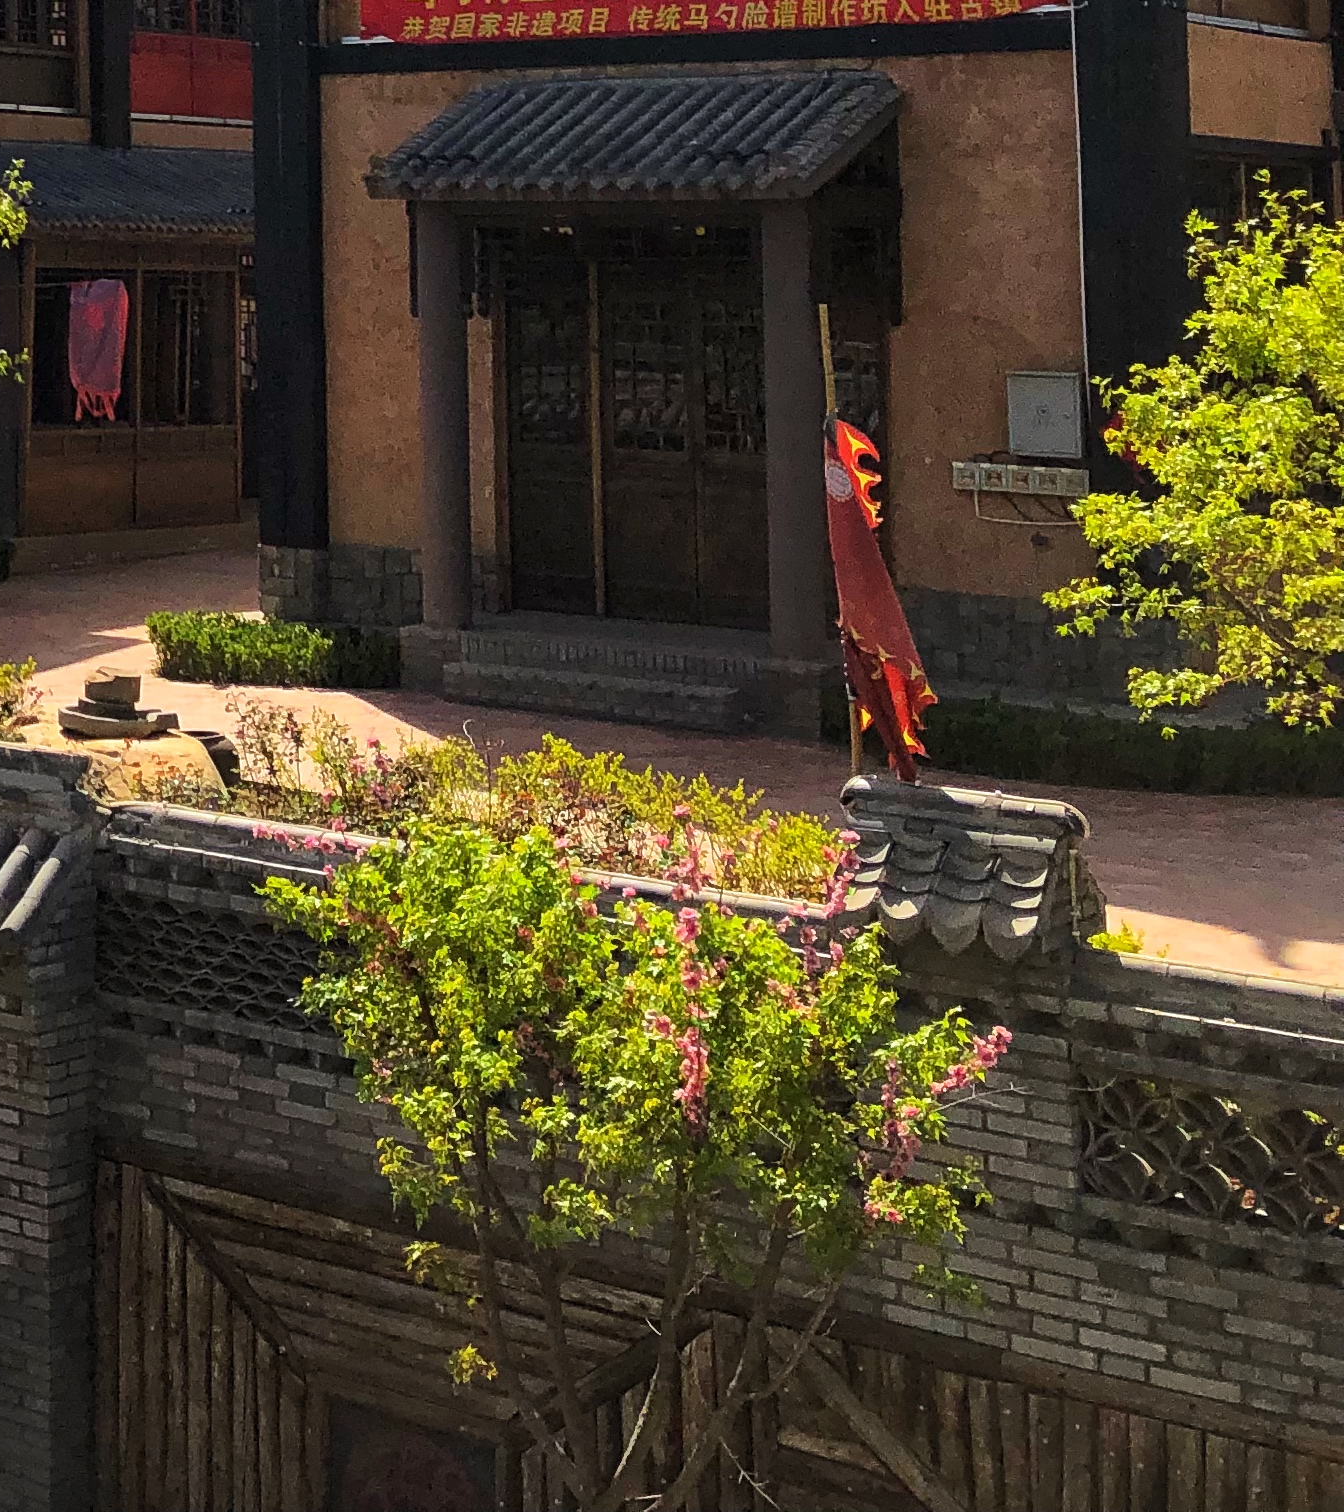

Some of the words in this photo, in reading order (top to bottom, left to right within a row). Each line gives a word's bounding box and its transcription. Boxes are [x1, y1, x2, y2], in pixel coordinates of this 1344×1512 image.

[401, 6, 610, 41] 恭贺国家非遗项目
